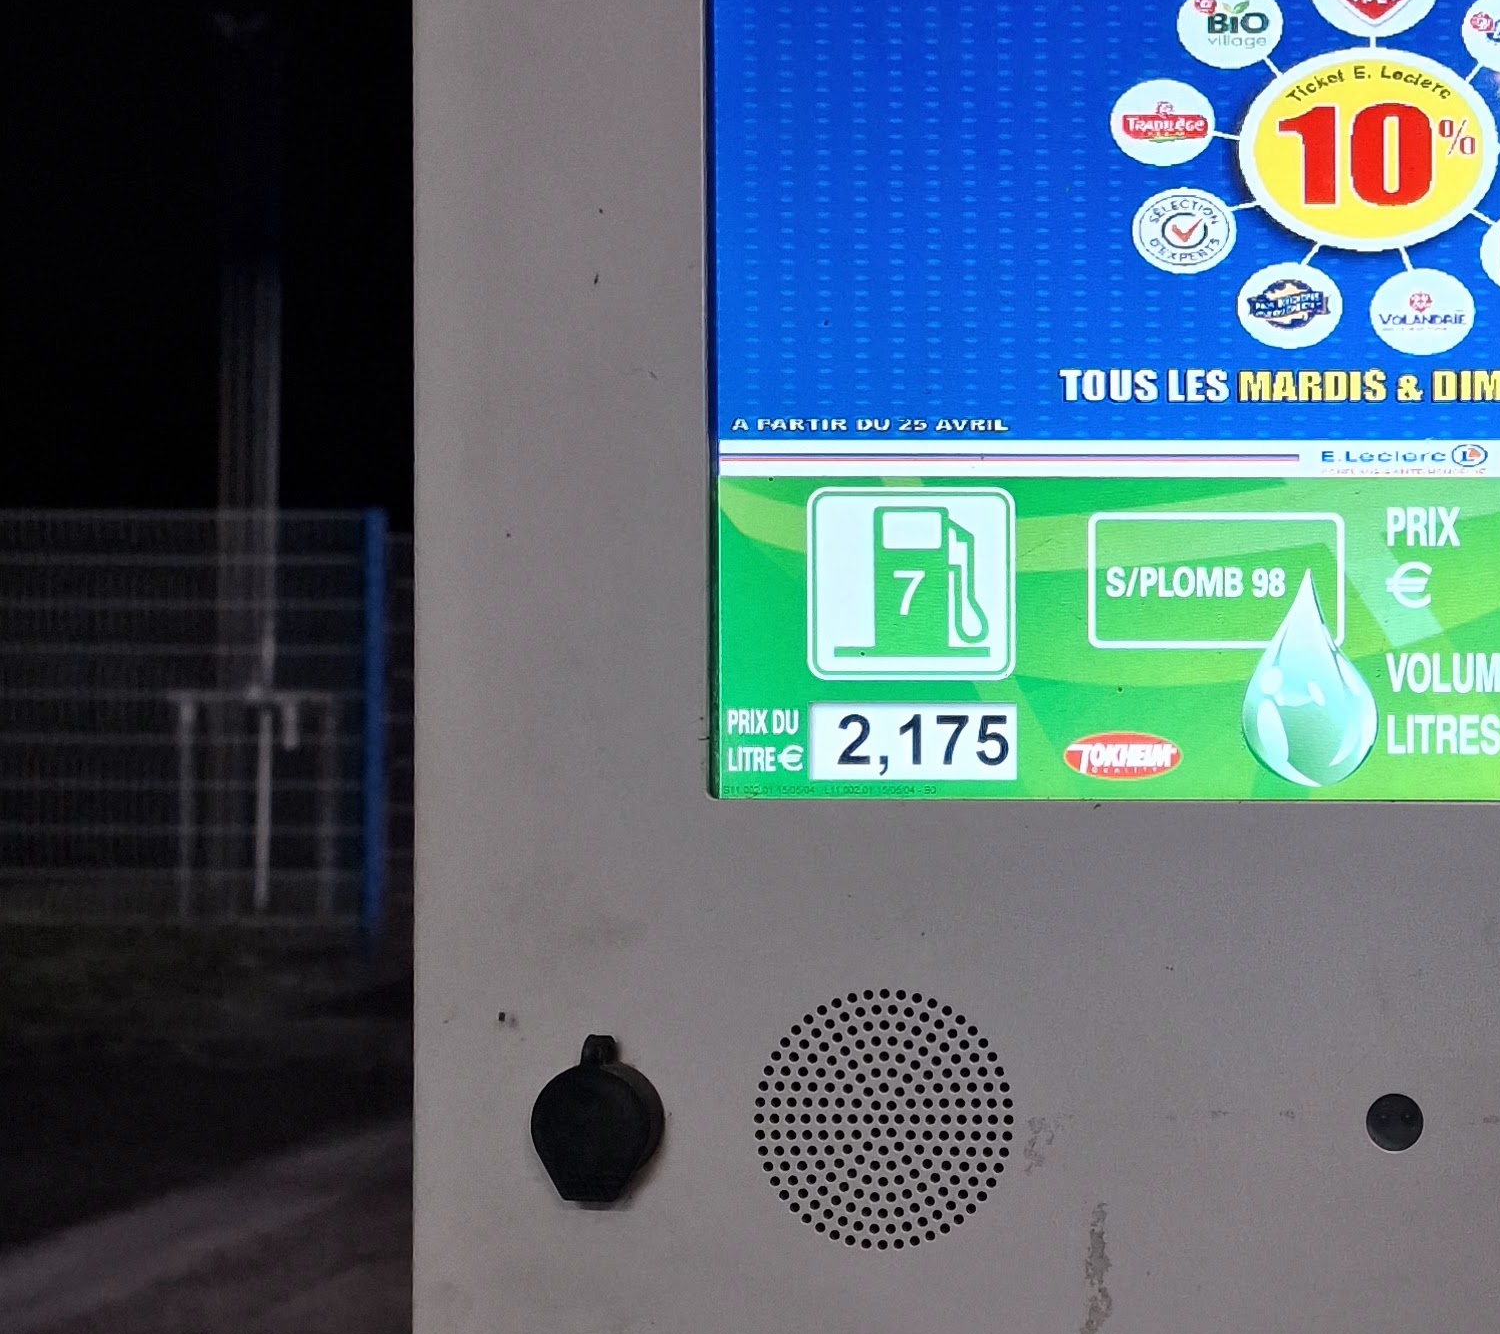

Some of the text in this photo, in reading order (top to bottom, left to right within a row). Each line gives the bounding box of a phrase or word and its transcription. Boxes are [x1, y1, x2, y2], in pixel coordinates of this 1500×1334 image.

[1208, 34, 1266, 49] village
[1285, 65, 1451, 101] Ticket E. Leclerc
[1060, 368, 1158, 402] TOUS
[1167, 368, 1230, 402] LES
[1238, 368, 1387, 403] MARDIS
[1396, 372, 1424, 402] &
[731, 419, 1009, 432] A PARTIR DU 25 AVRIL
[1386, 506, 1462, 547] PRIX
[893, 570, 925, 616] 7
[1105, 567, 1286, 599] S/PLOMB 98
[1385, 560, 1433, 609] €
[726, 707, 799, 735] PRIX DU
[726, 746, 777, 773] LITRE
[837, 712, 1010, 777] 2,175
